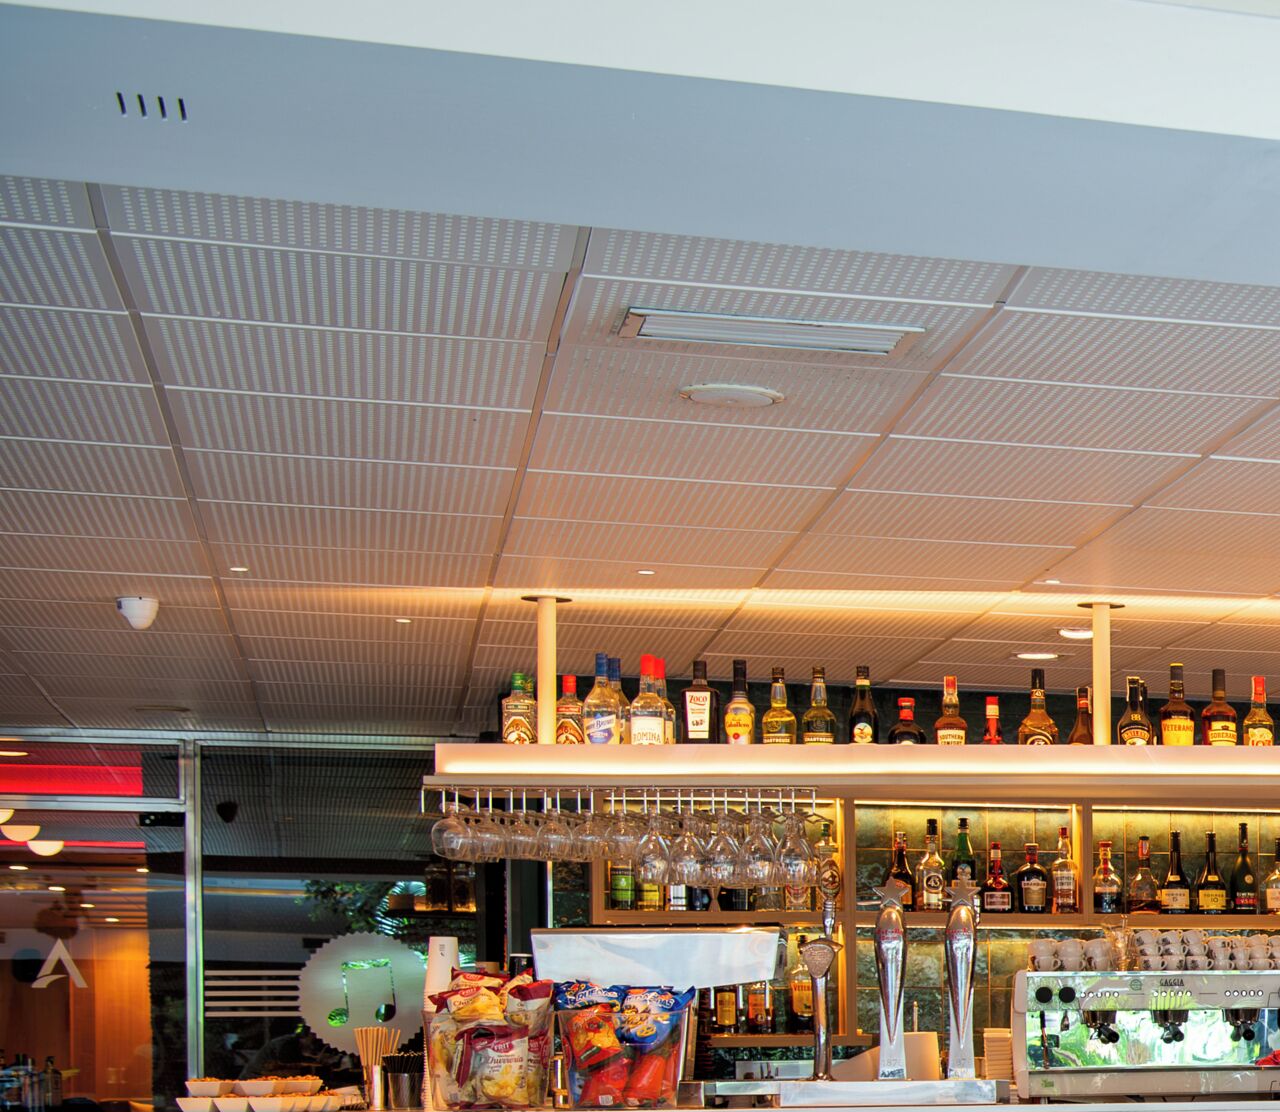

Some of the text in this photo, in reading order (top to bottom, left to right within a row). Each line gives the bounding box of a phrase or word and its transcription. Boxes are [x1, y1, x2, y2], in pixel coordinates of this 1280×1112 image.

[928, 877, 941, 888] 43
[1159, 978, 1185, 987] GAGGIA
[493, 1042, 511, 1052] FRIT
